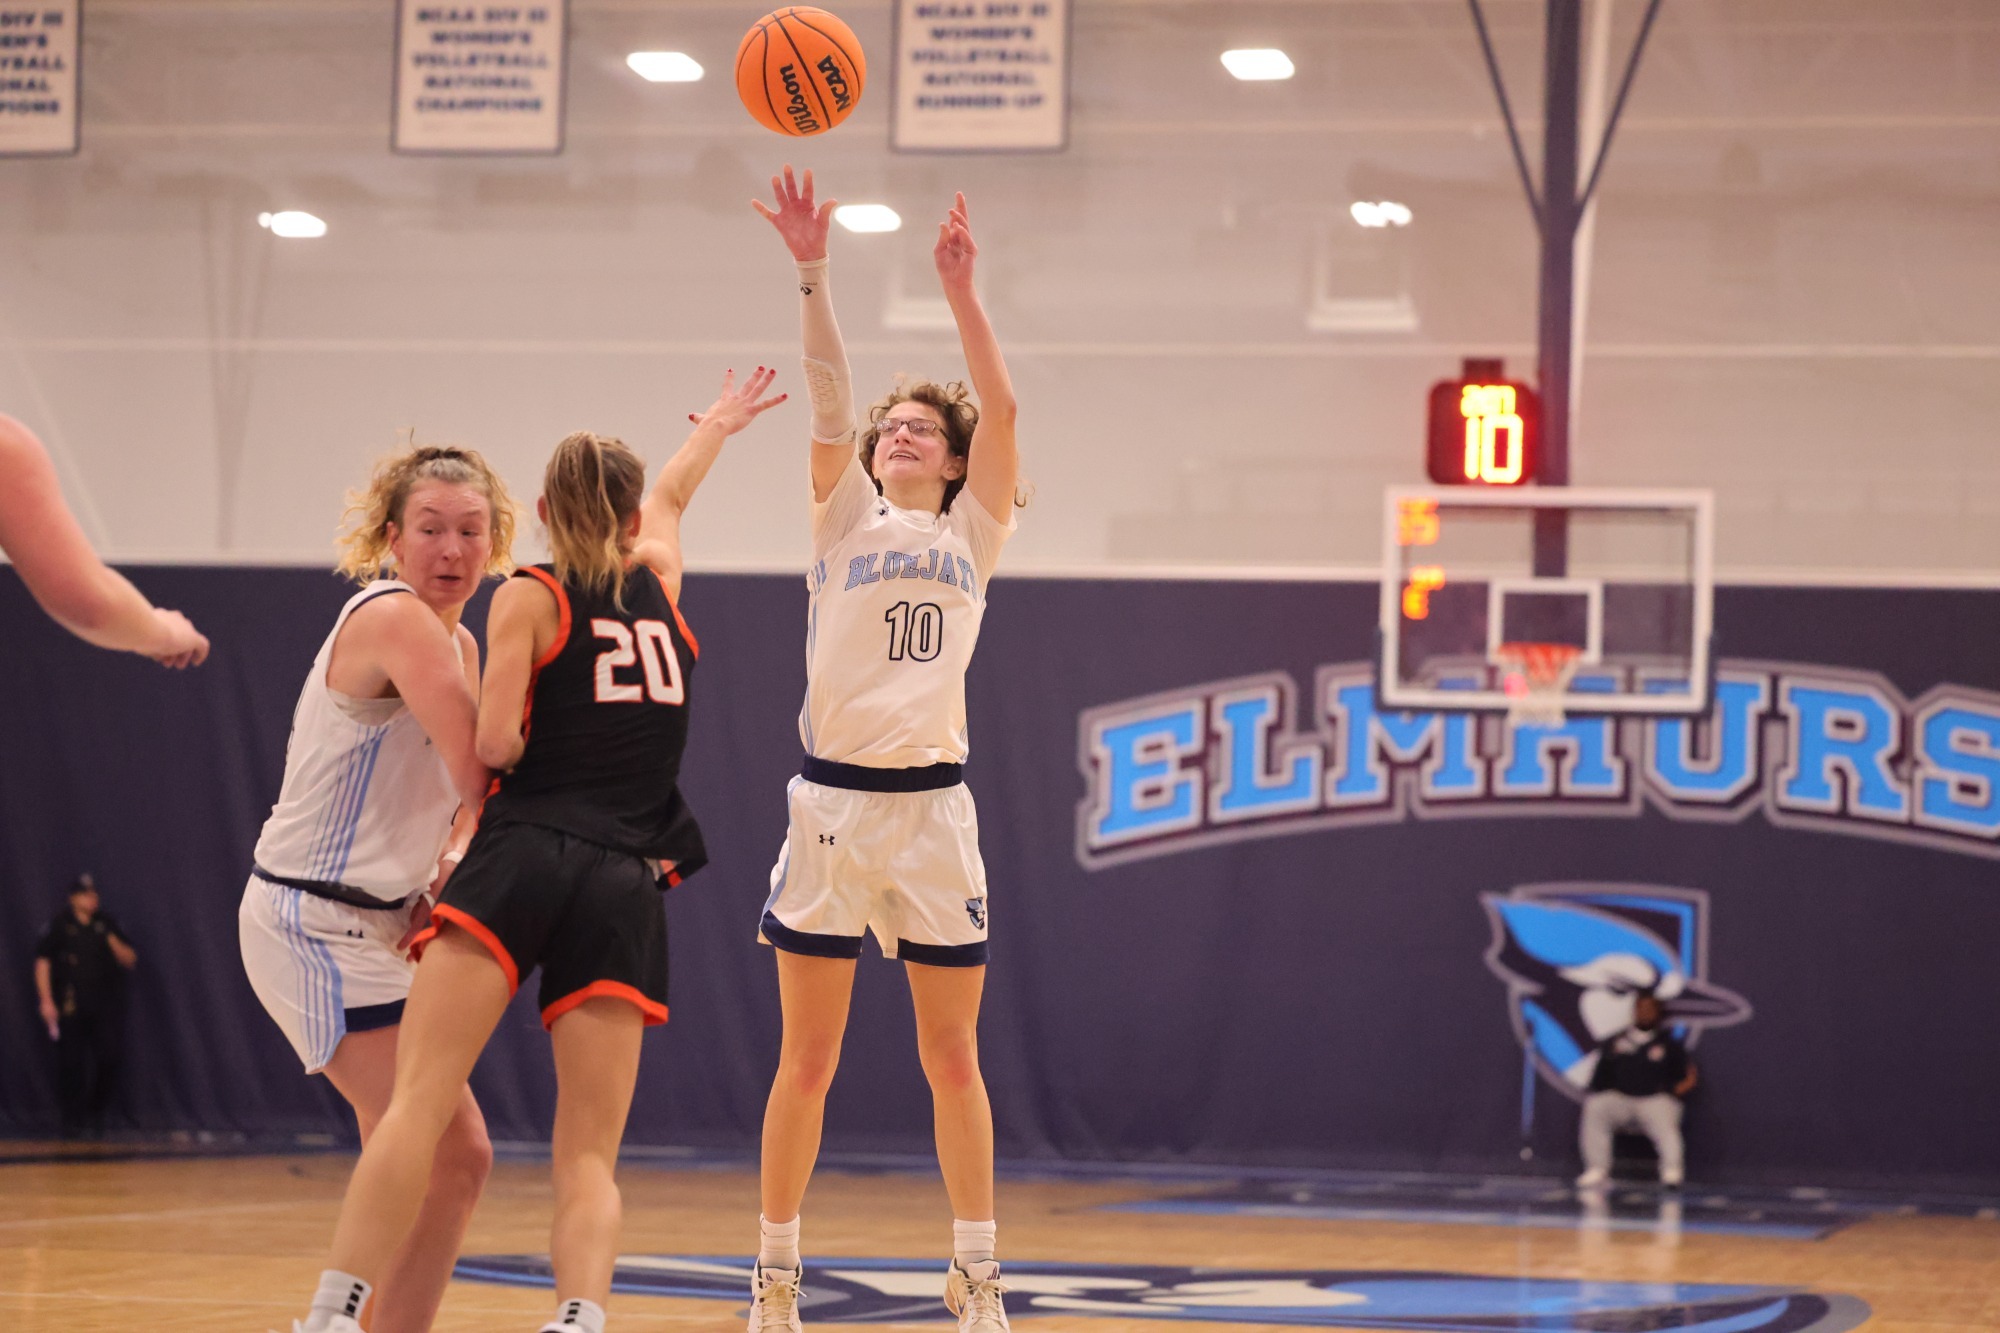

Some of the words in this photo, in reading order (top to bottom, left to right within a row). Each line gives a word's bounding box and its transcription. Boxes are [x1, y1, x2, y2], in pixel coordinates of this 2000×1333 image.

[779, 62, 821, 134] Wilson
[816, 54, 851, 113] NCAA
[1464, 414, 1524, 484] 10
[589, 617, 685, 707] 20
[884, 600, 944, 663] 10
